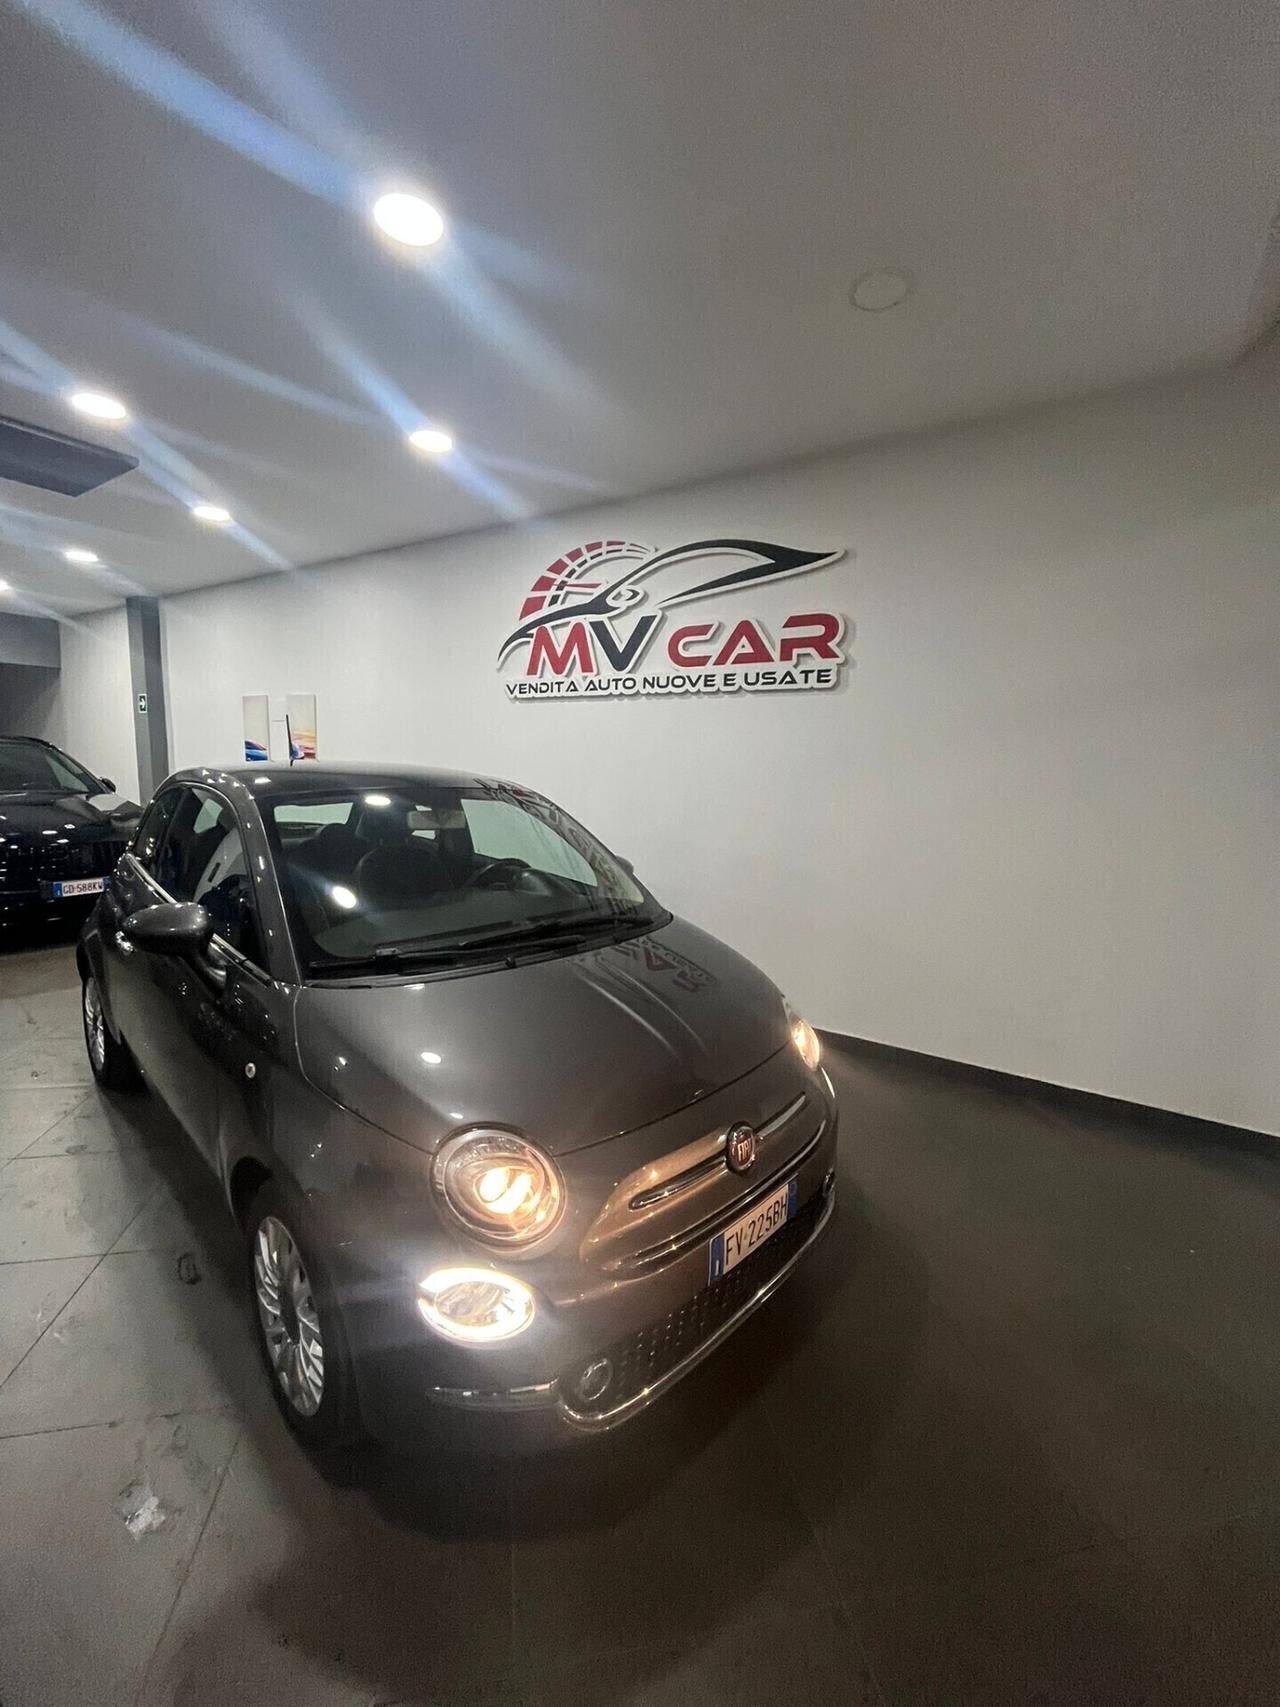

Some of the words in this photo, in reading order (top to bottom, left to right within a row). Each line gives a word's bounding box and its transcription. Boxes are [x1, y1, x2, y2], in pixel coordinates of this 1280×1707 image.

[527, 615, 658, 675] MV
[667, 613, 840, 668] CAR
[506, 681, 579, 695] VENDITA
[584, 677, 637, 691] AUTO
[643, 674, 716, 690] NUOVE
[723, 673, 737, 687] E
[744, 669, 833, 686] USATE
